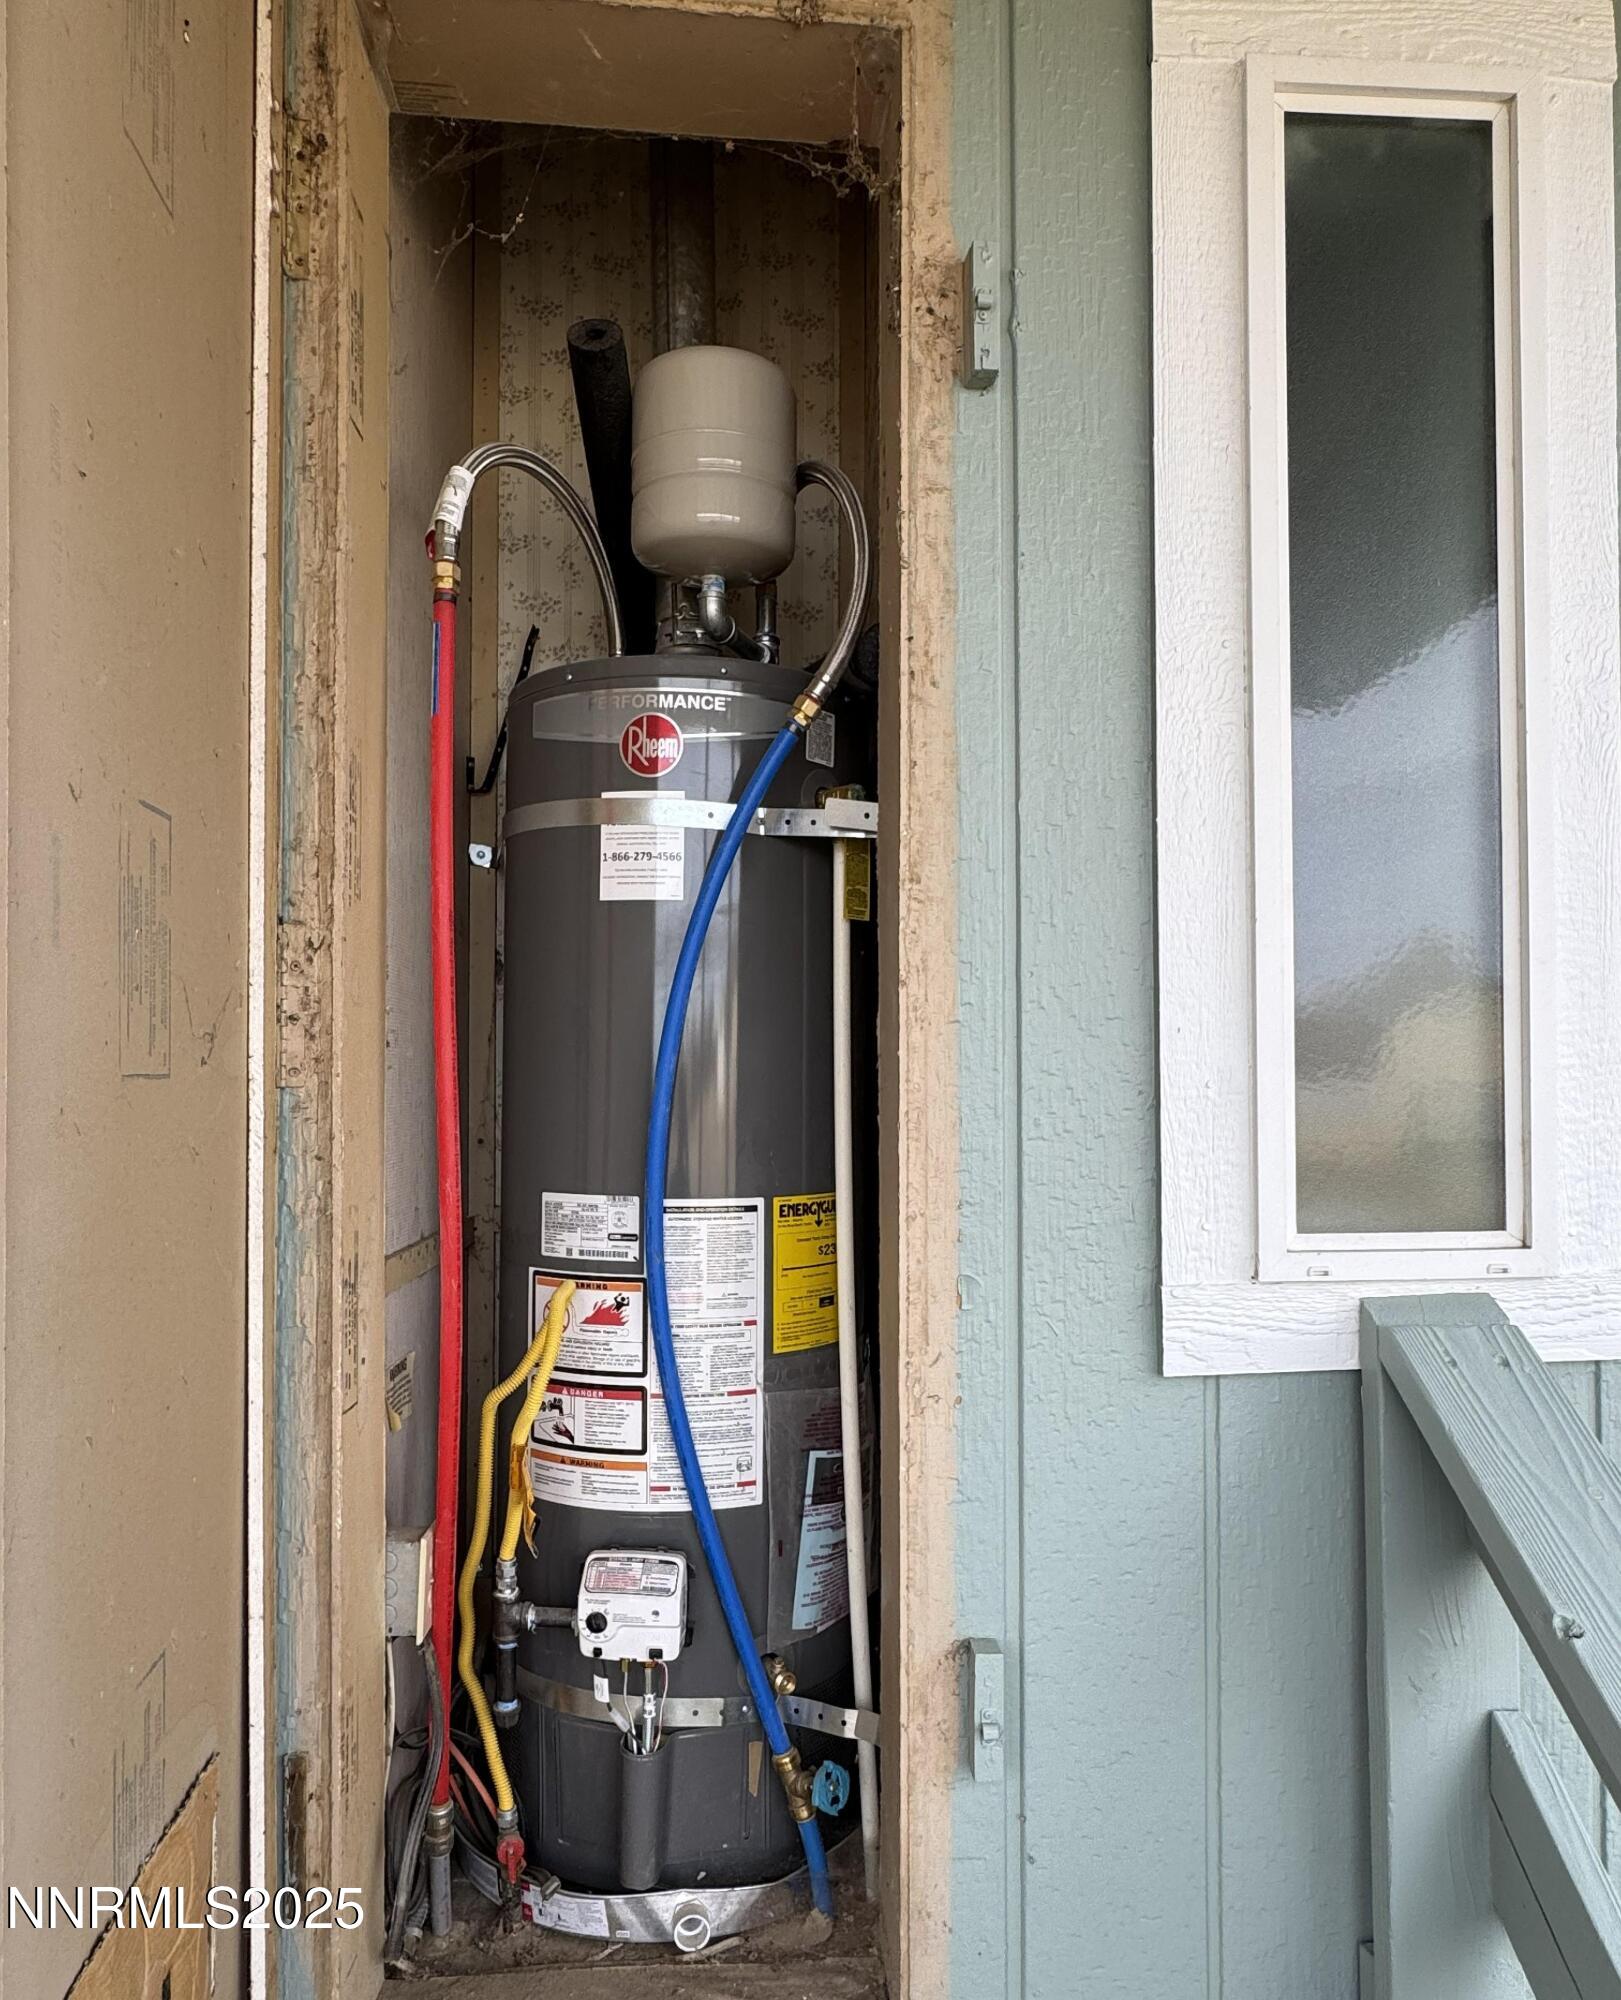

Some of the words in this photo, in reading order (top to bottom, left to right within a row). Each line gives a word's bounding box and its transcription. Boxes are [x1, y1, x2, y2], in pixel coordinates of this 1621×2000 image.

[627, 716, 678, 767] Rheem
[602, 851, 682, 863] 1-866-279-4566
[569, 1389, 604, 1398] DANGER
[569, 1458, 605, 1469] WARNING
